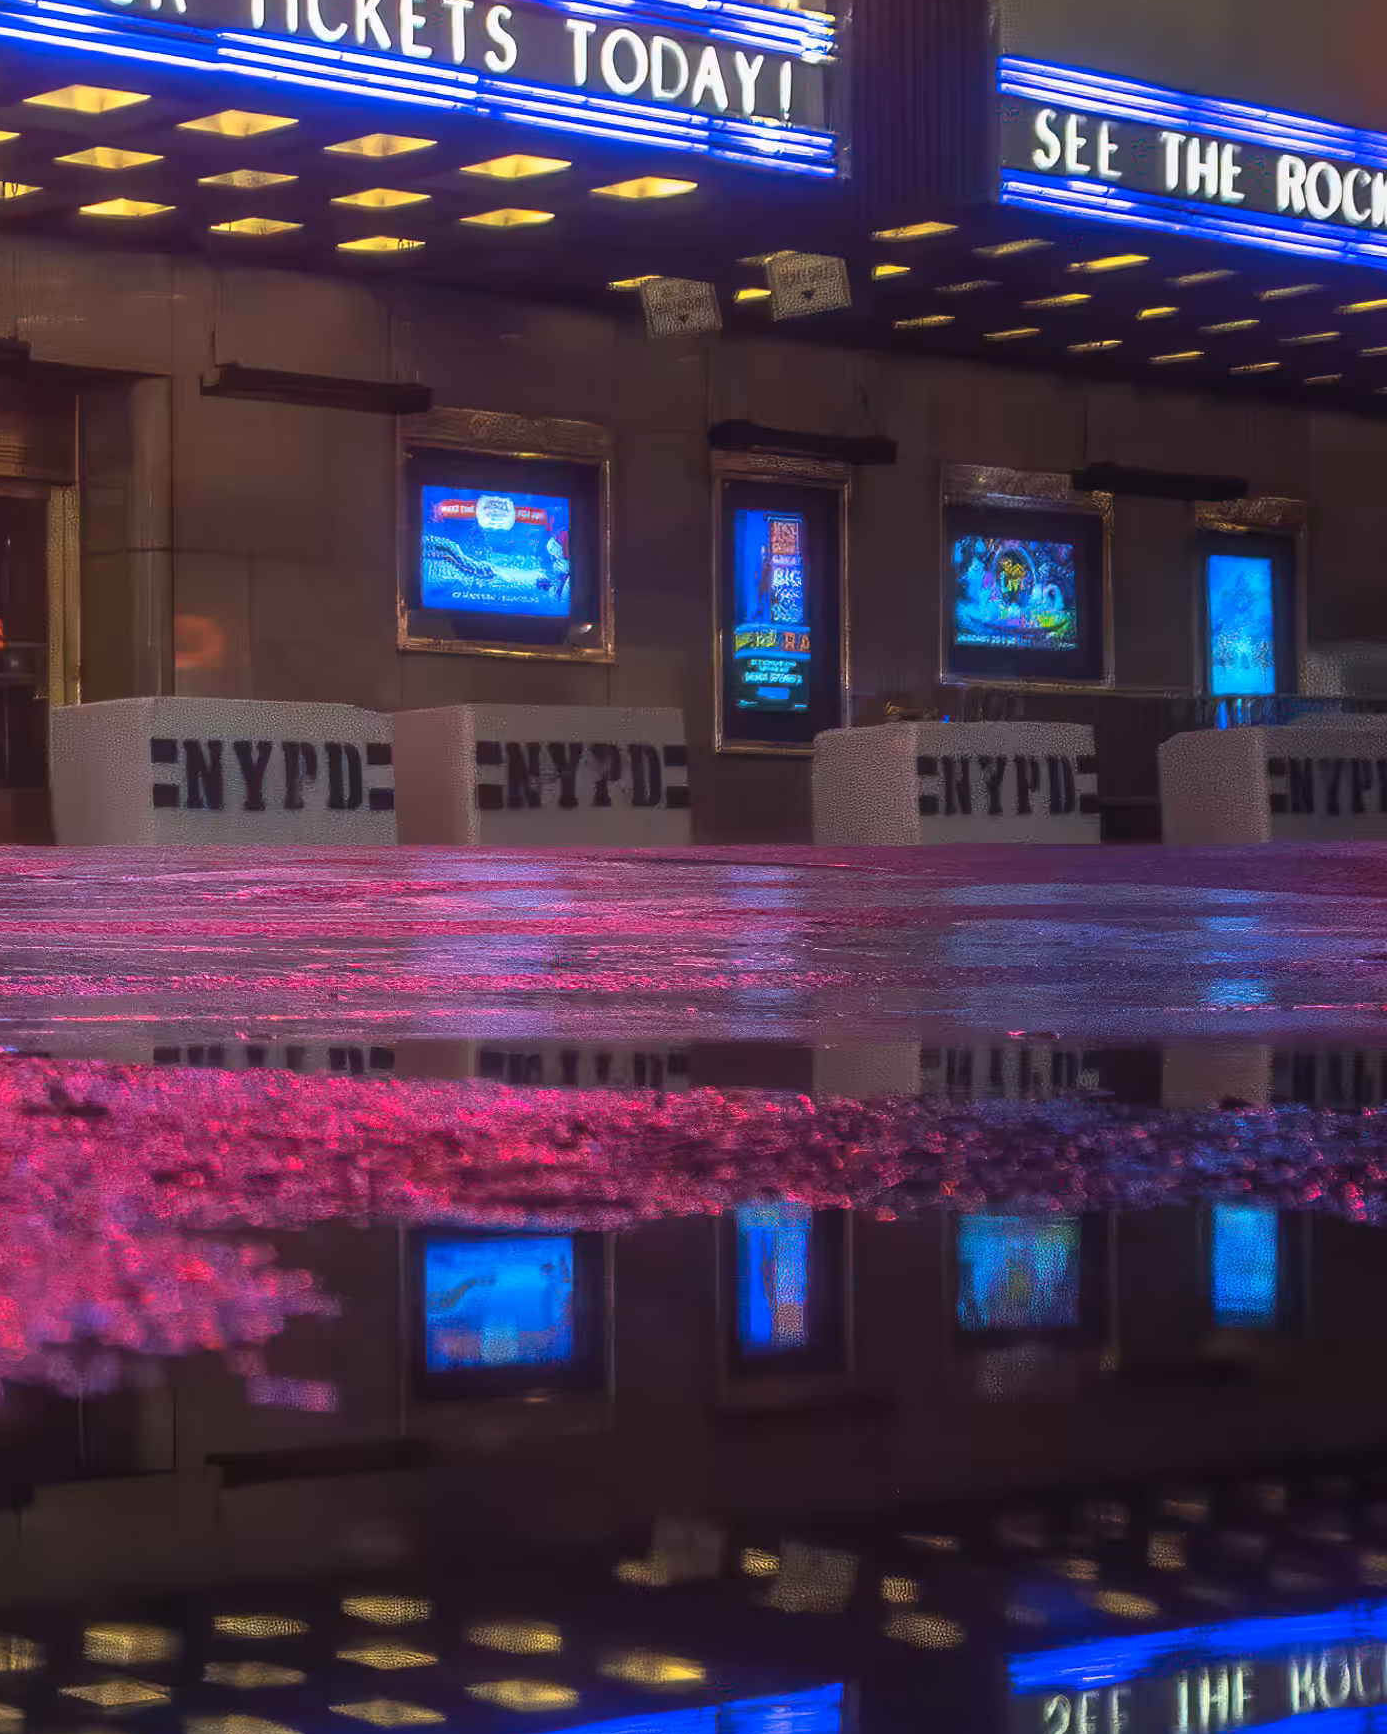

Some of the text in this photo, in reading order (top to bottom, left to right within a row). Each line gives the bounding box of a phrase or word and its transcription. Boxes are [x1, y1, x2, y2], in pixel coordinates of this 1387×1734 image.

[565, 18, 794, 121] TODAY!
[1031, 108, 1122, 180] SEE
[1159, 131, 1246, 204] THE
[183, 737, 365, 811] NYPD
[504, 739, 666, 810] NYPD
[941, 754, 1077, 815] NYPD
